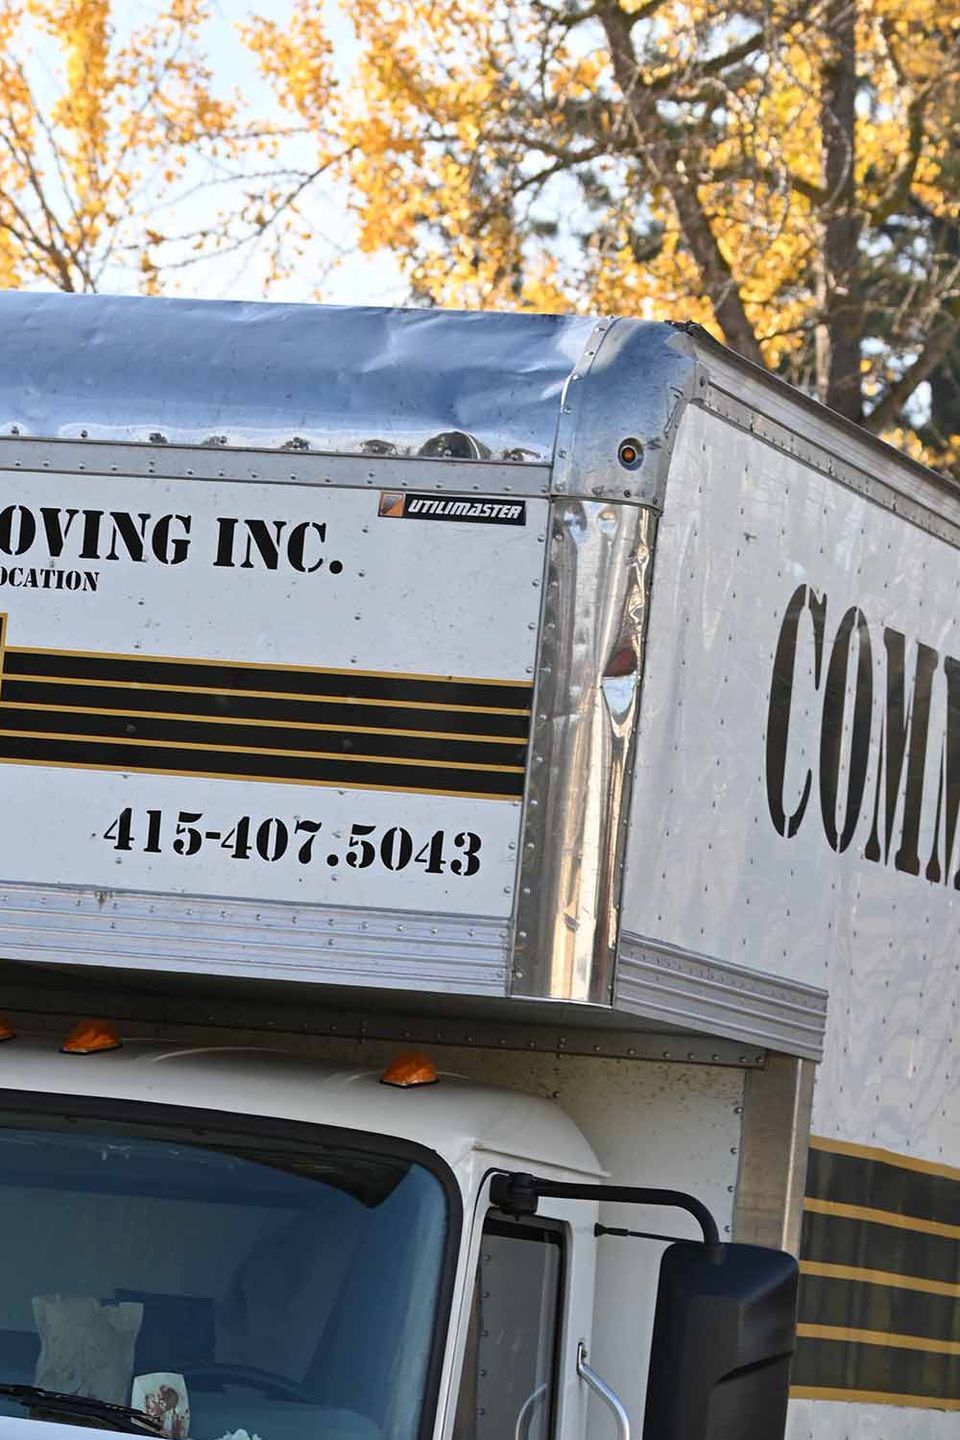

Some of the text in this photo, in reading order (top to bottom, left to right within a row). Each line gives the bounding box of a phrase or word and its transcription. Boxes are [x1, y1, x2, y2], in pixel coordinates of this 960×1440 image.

[408, 499, 523, 519] UTILIMASTER
[212, 517, 344, 575] INC.
[103, 806, 483, 877] 415-407.5043
